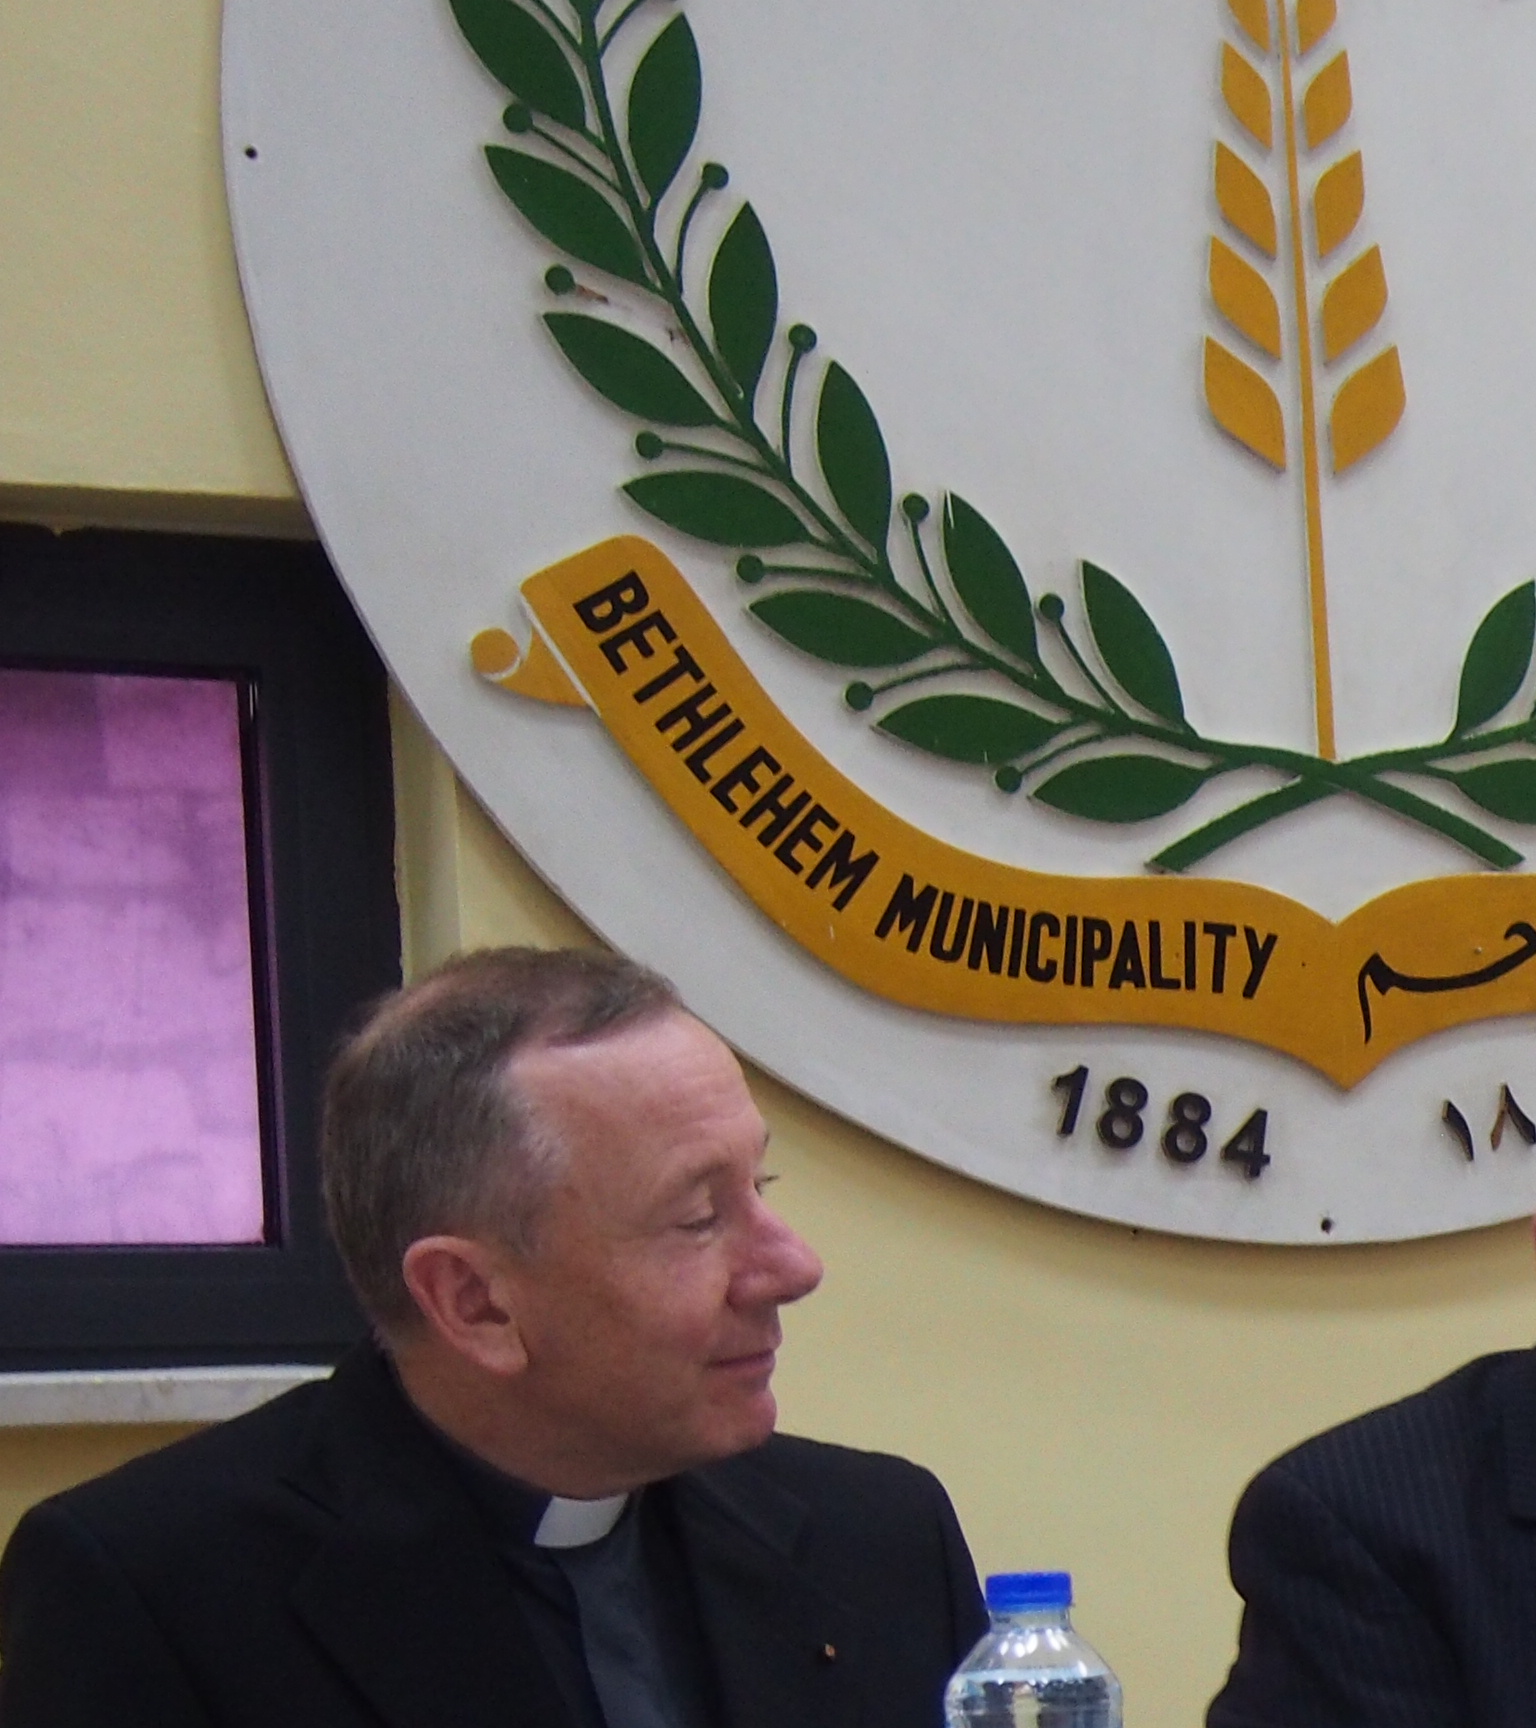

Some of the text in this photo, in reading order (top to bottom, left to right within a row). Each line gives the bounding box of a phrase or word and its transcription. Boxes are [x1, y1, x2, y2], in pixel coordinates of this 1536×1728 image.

[572, 570, 1278, 1000] BETHLEHEM MUNICIPALITY
[1051, 1064, 1271, 1181] 1884
